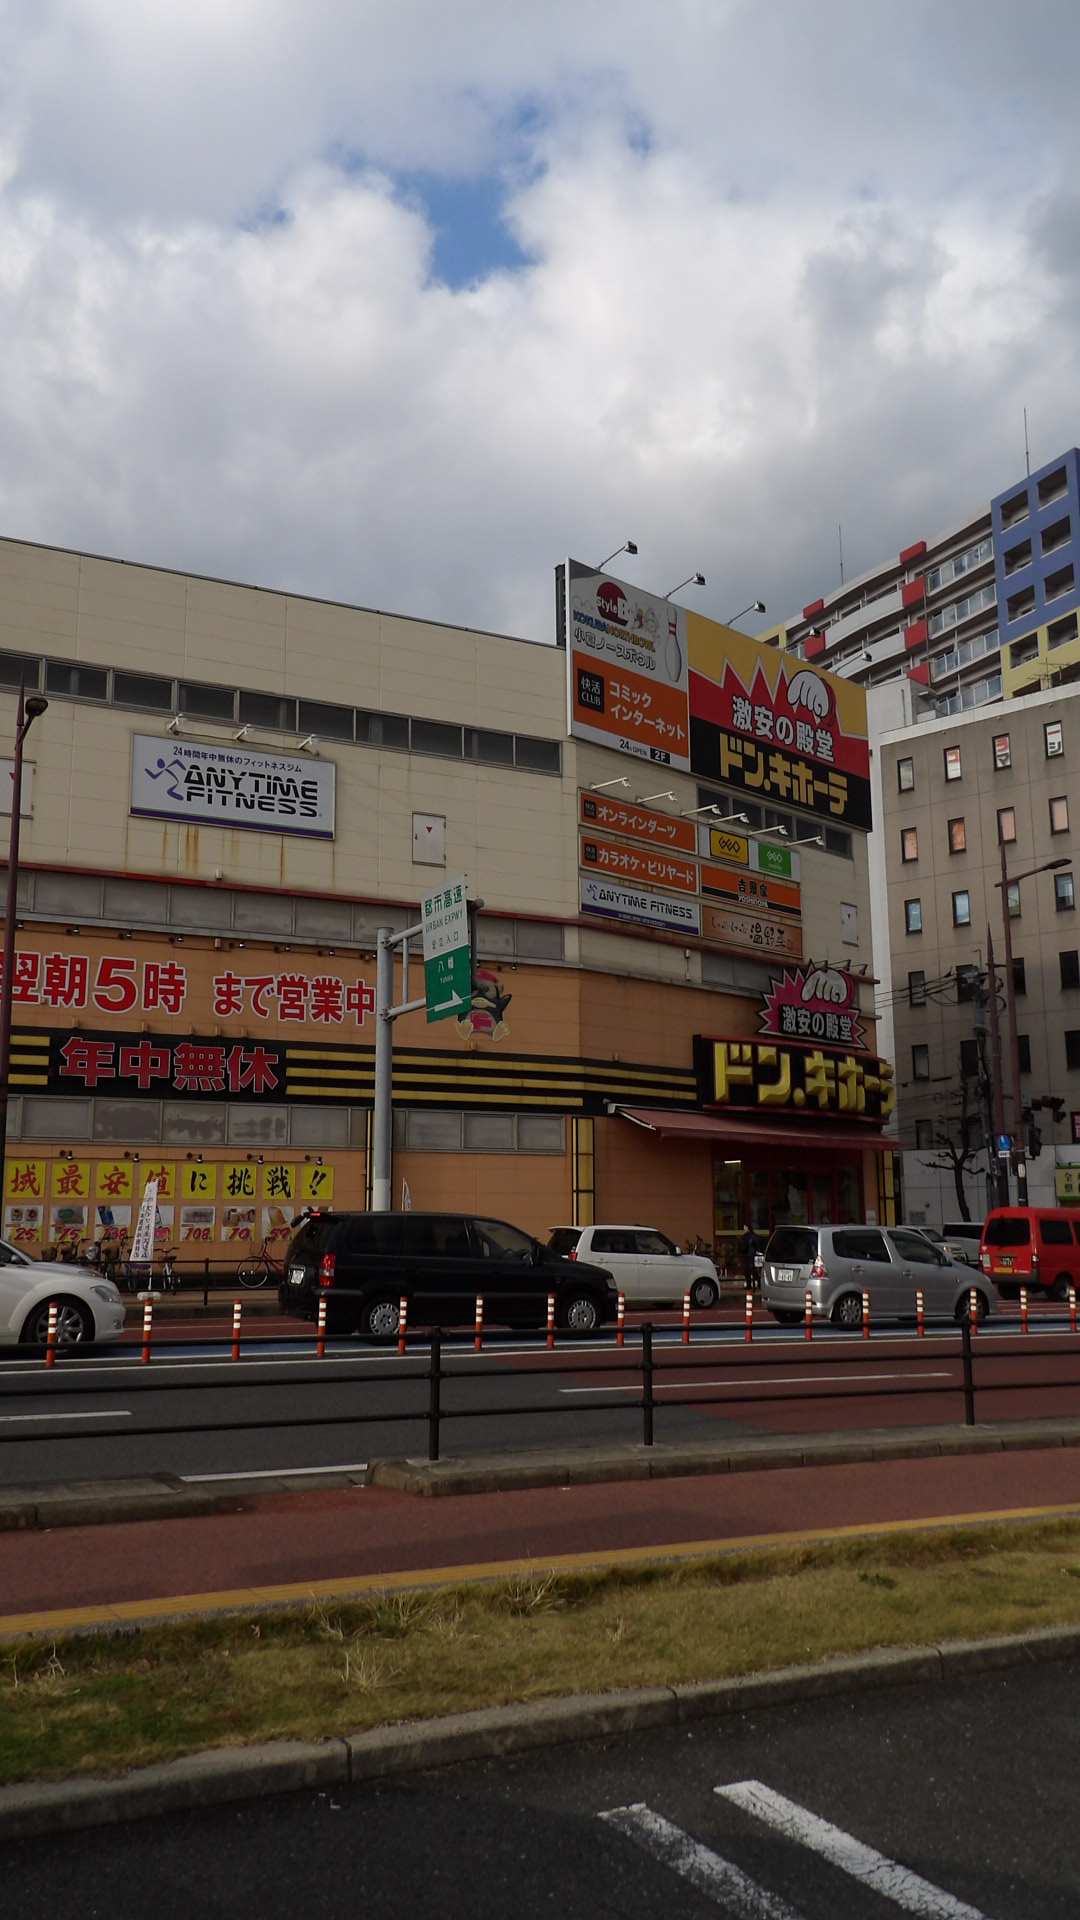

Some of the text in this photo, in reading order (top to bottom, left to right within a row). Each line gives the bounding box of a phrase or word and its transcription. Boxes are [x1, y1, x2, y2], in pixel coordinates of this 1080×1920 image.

[574, 627, 656, 670] 小倉ノースボウル
[581, 677, 600, 694] 快活
[581, 691, 601, 706] CLUB
[610, 681, 652, 708] コミック
[610, 704, 685, 740] インターネット
[732, 695, 834, 762] 激安の殿堂
[173, 746, 302, 773] 24時間年中無休のフィットネスジム
[654, 750, 666, 761] 2F
[184, 764, 318, 800] ANYTIME
[186, 786, 318, 817] FITNESS
[598, 806, 677, 838] オンラインダーツ
[599, 848, 694, 884] カラオケ・ビリヤード
[424, 885, 462, 917] 都市高速
[599, 889, 692, 919] ANYTIME FITNESS
[425, 909, 463, 933] URBAN EXPWY
[213, 970, 377, 1026] まで営業中
[783, 1005, 853, 1041] 激安の殿堂
[59, 1036, 279, 1093] 年中無休
